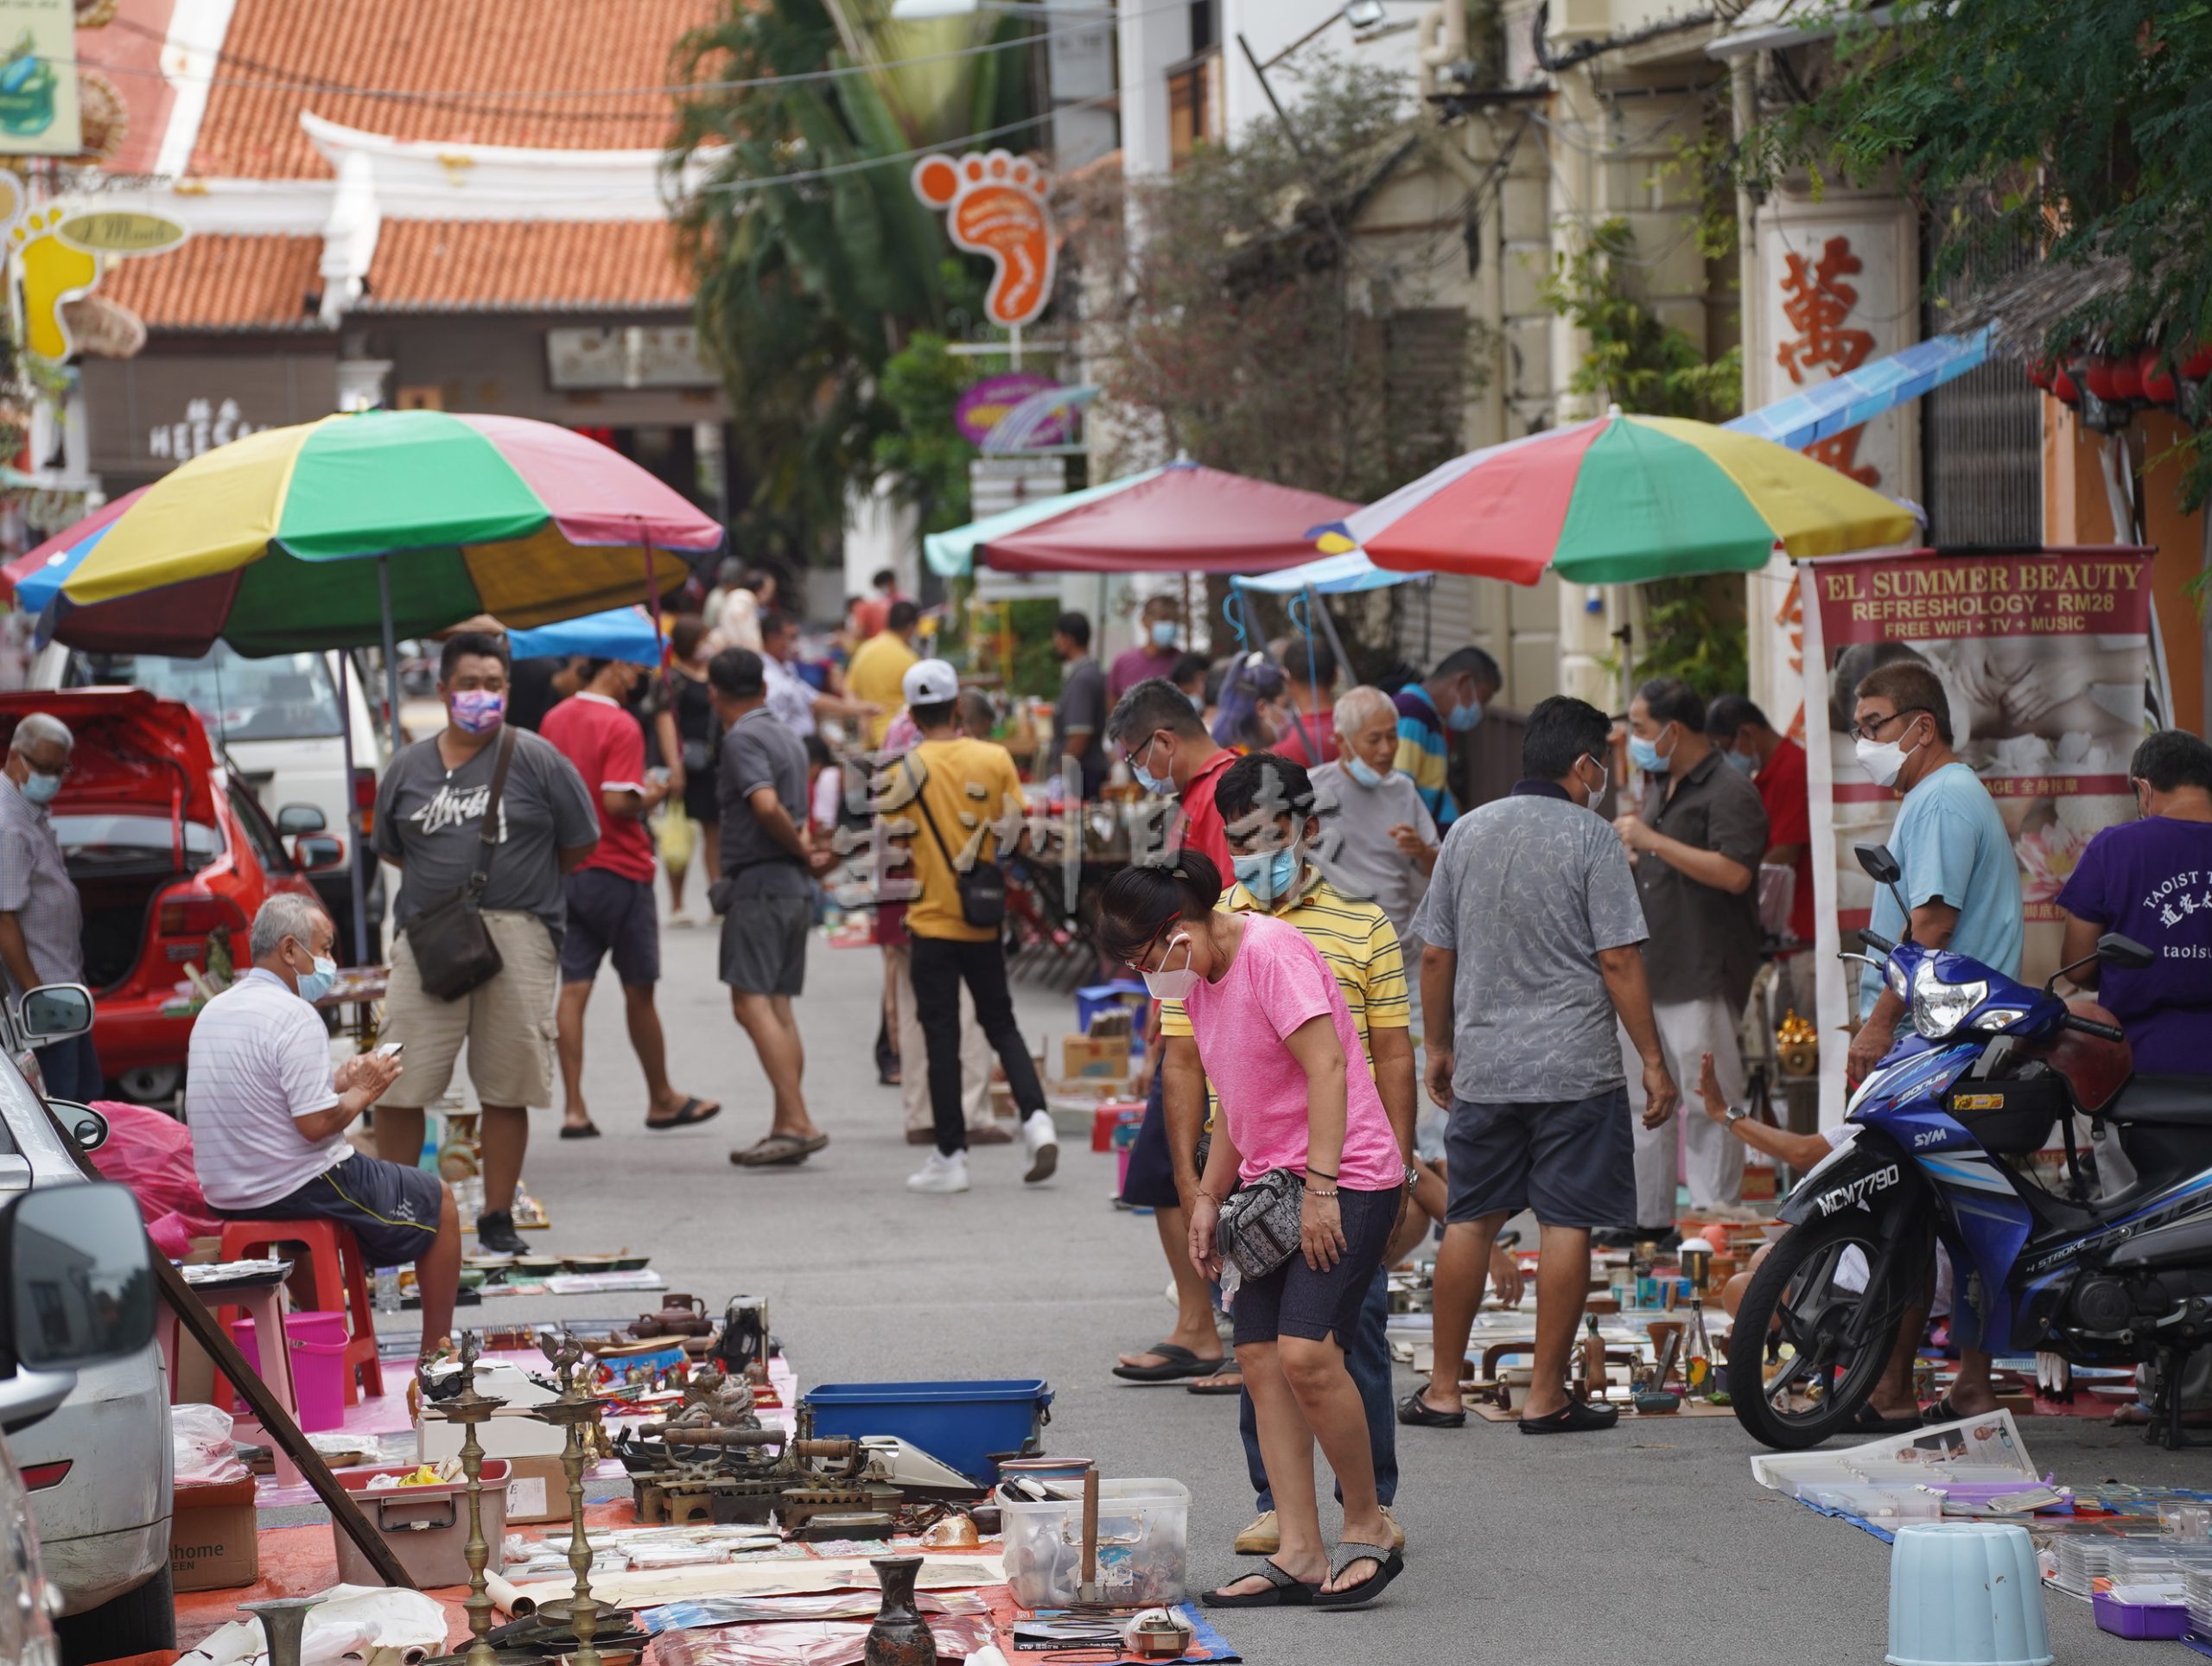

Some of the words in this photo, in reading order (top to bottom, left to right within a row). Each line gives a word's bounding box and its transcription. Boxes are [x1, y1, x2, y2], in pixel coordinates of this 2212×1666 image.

[1825, 574, 1866, 601] EL
[1872, 566, 2012, 599] SUMMER
[2018, 563, 2144, 592] BEAUTY
[1852, 595, 2037, 621] REFRESHOLOGY
[2057, 594, 2114, 613] RM28
[1885, 620, 1930, 638] FREE
[1935, 620, 1972, 636] WIFI
[1989, 617, 2012, 632] TV
[2031, 616, 2085, 632] MUSIC
[2143, 871, 2199, 909] TAOIST
[1914, 1128, 1947, 1147] SYM
[2037, 1237, 2087, 1269] STROKE
